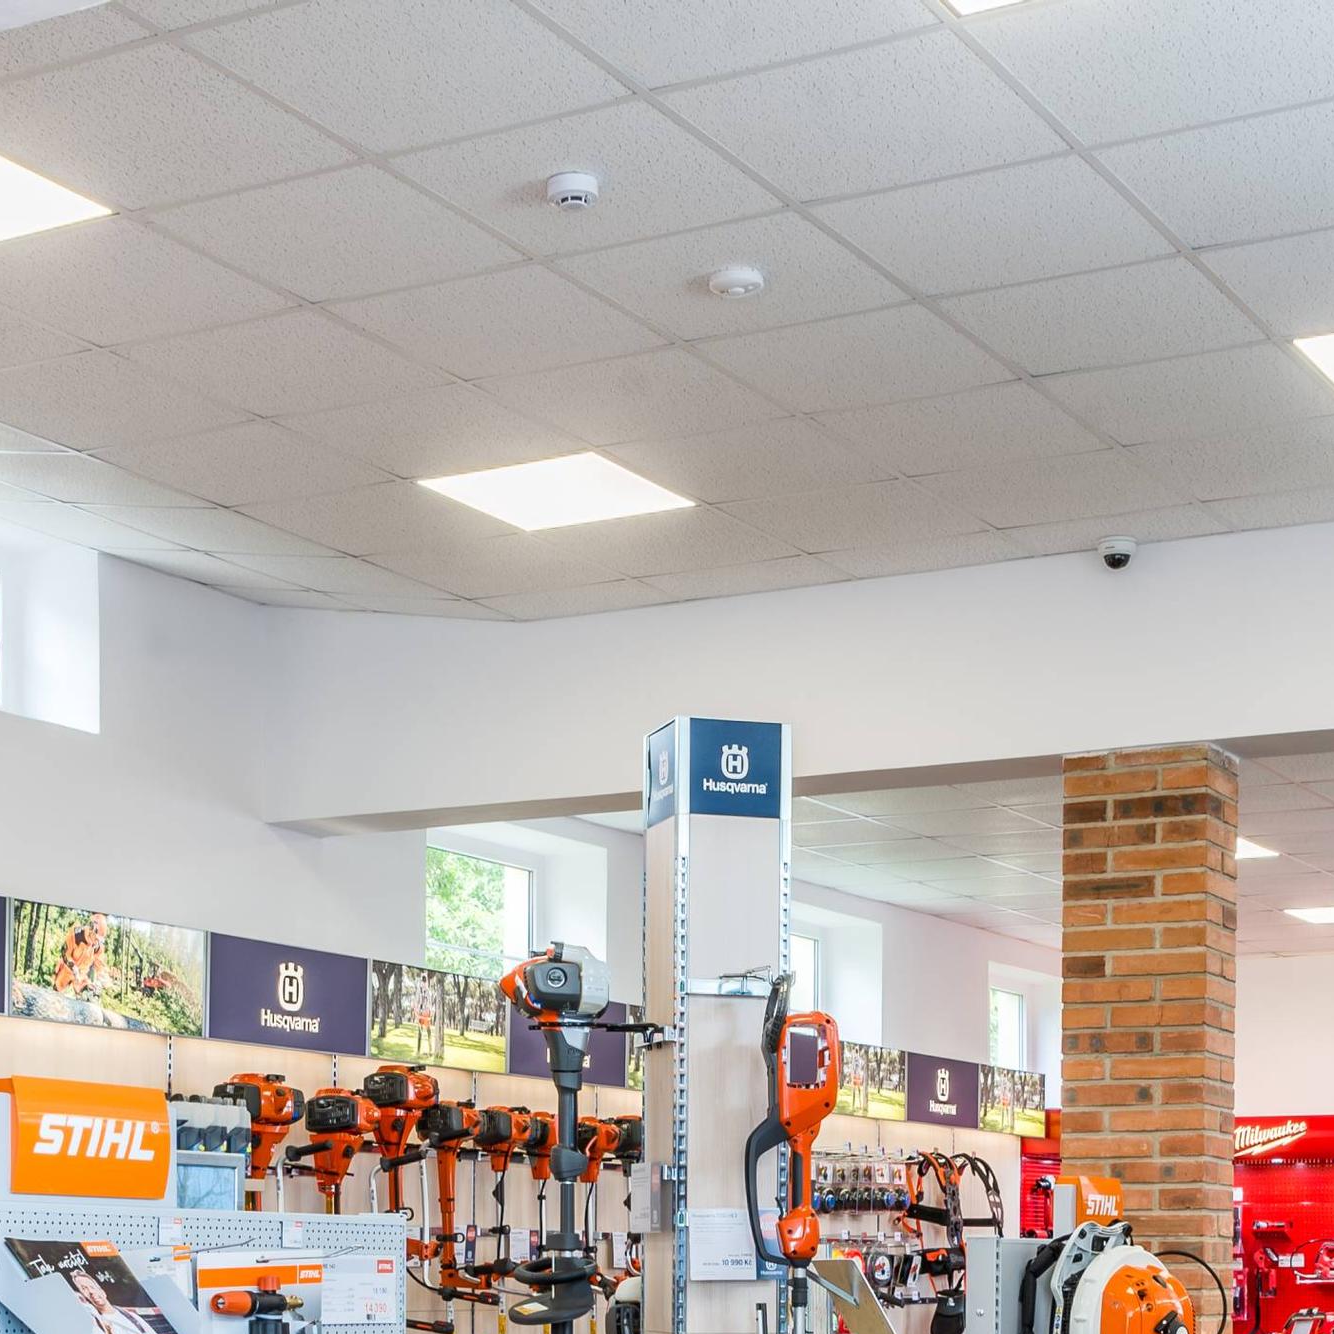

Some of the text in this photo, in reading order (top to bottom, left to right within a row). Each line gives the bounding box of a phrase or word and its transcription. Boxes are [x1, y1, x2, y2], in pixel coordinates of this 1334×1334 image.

[703, 778, 767, 795] Husqvarna
[260, 1008, 320, 1033] Husqvarna
[33, 1113, 157, 1161] STIHL
[1234, 1119, 1307, 1150] Milwaukee
[1086, 1194, 1119, 1217] STIHL
[299, 1269, 321, 1280] STIHL
